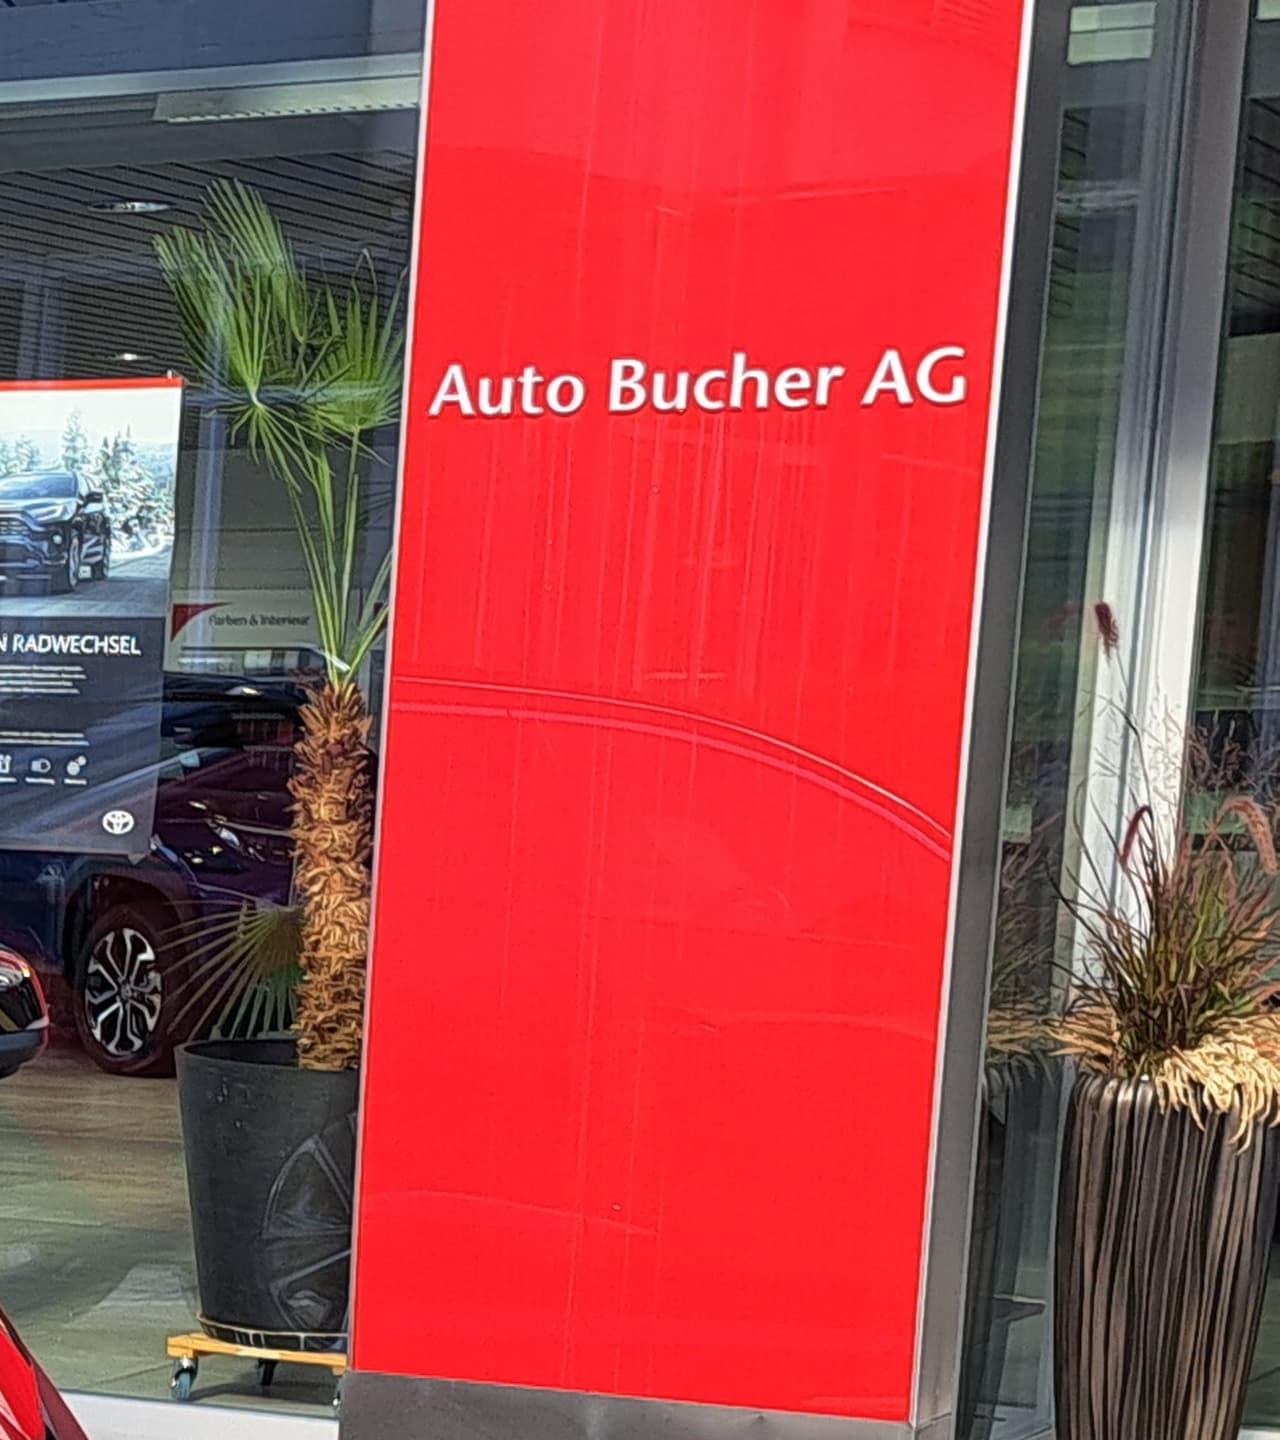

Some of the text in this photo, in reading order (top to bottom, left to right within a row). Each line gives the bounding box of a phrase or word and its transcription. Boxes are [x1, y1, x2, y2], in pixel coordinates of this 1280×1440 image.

[428, 346, 967, 417] Auto Bucher AG
[12, 633, 142, 656] RADWECHSEL
